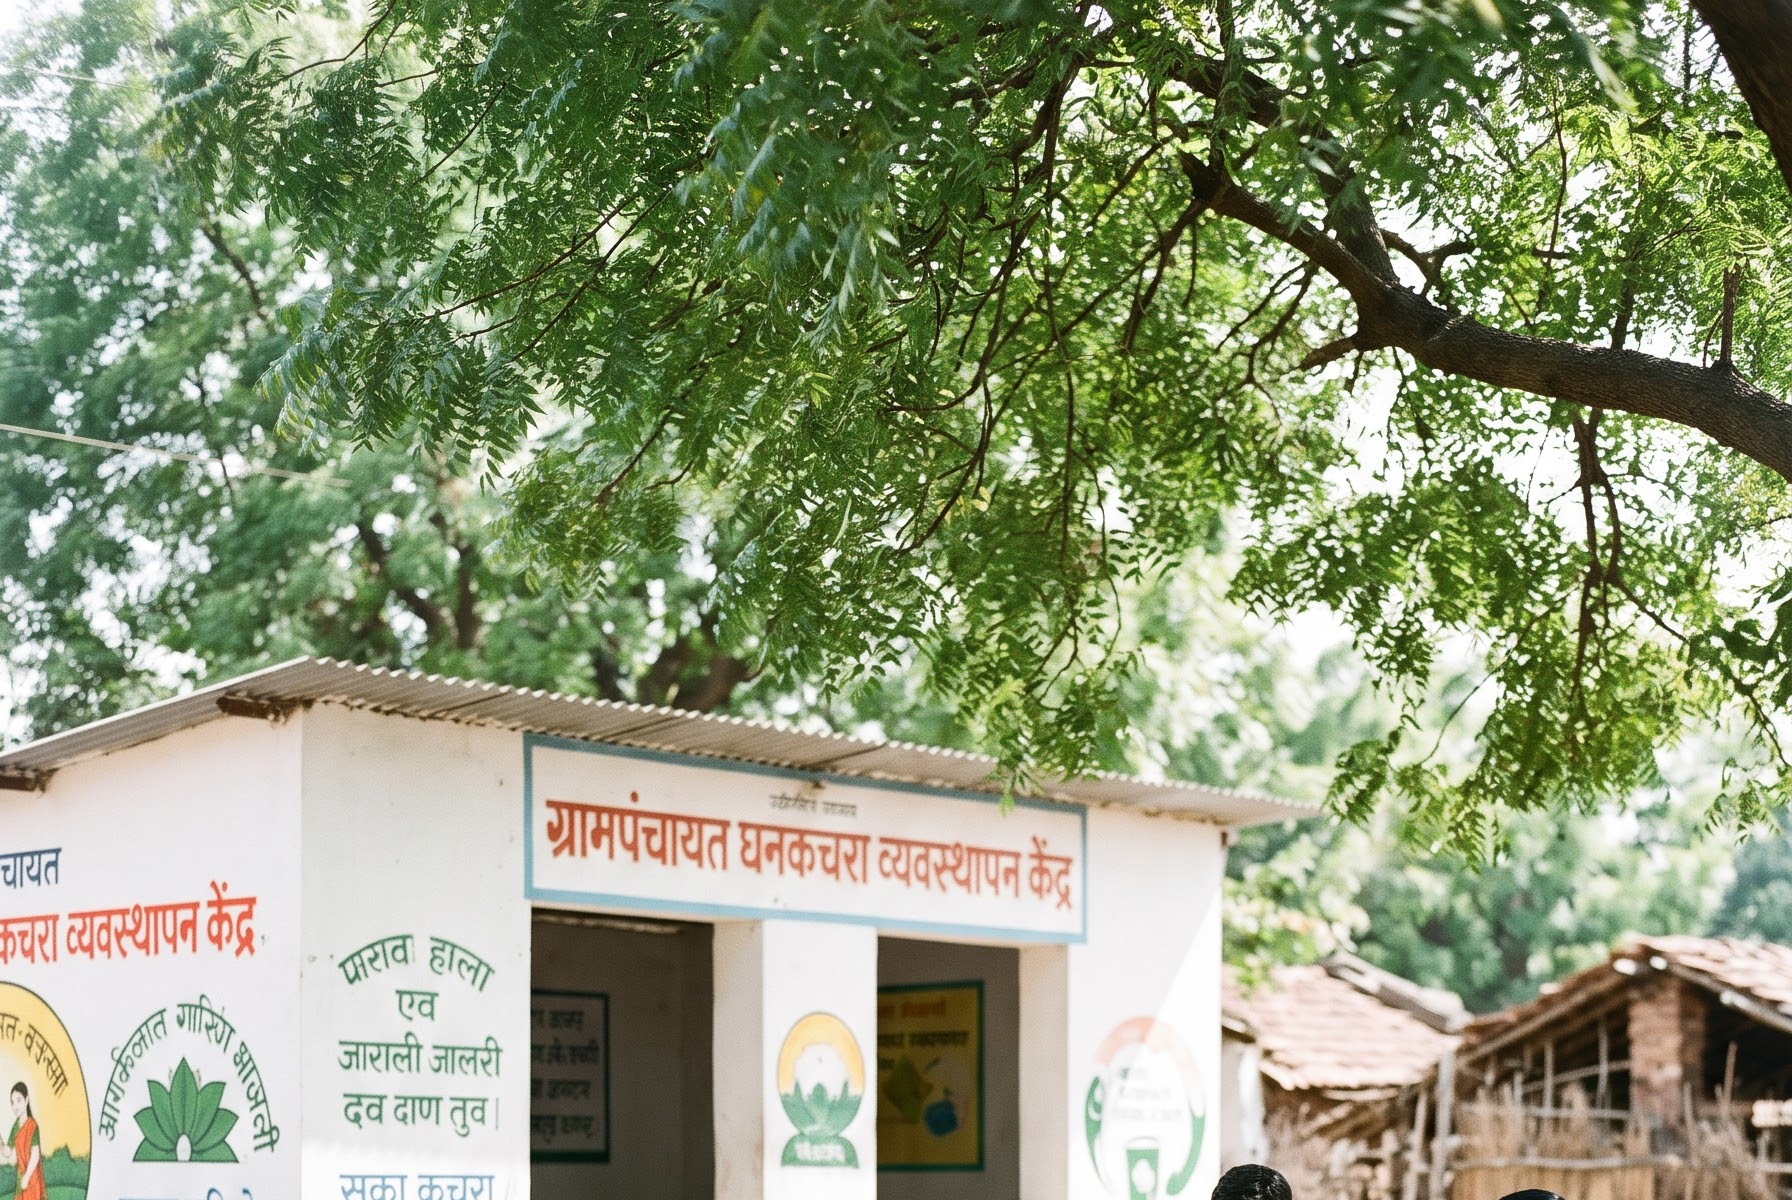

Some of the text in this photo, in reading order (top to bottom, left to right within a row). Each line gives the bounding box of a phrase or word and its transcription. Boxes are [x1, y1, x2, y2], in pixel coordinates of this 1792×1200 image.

[545, 790, 1073, 911] ग्रामपंचायत घनकचरा व्यवस्थापन केंद्र
[66, 901, 200, 959] व्यवस्थापन
[206, 880, 257, 958] केंद्र
